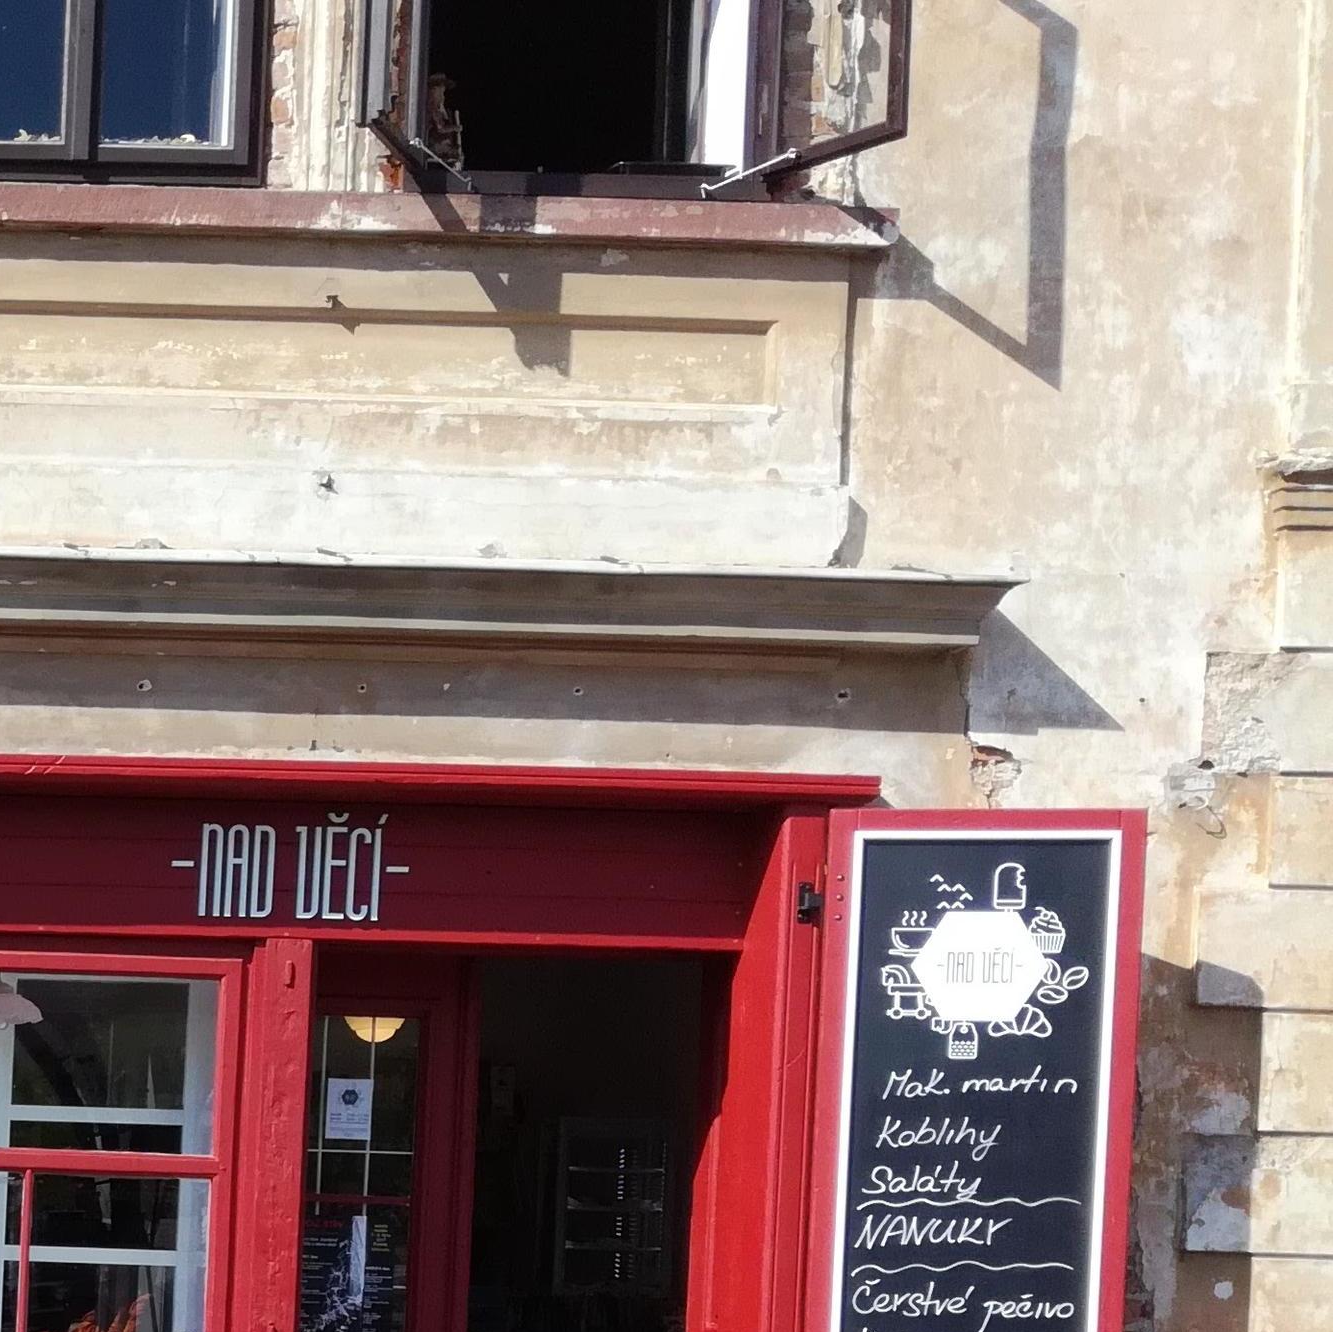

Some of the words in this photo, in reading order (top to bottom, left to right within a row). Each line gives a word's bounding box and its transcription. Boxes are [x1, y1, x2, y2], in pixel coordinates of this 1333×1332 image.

[876, 1115, 1002, 1161] Koblihy
[861, 1160, 982, 1200] Saláty
[854, 1214, 1013, 1250] NANUKY
[851, 1278, 975, 1317] Čerstvé
